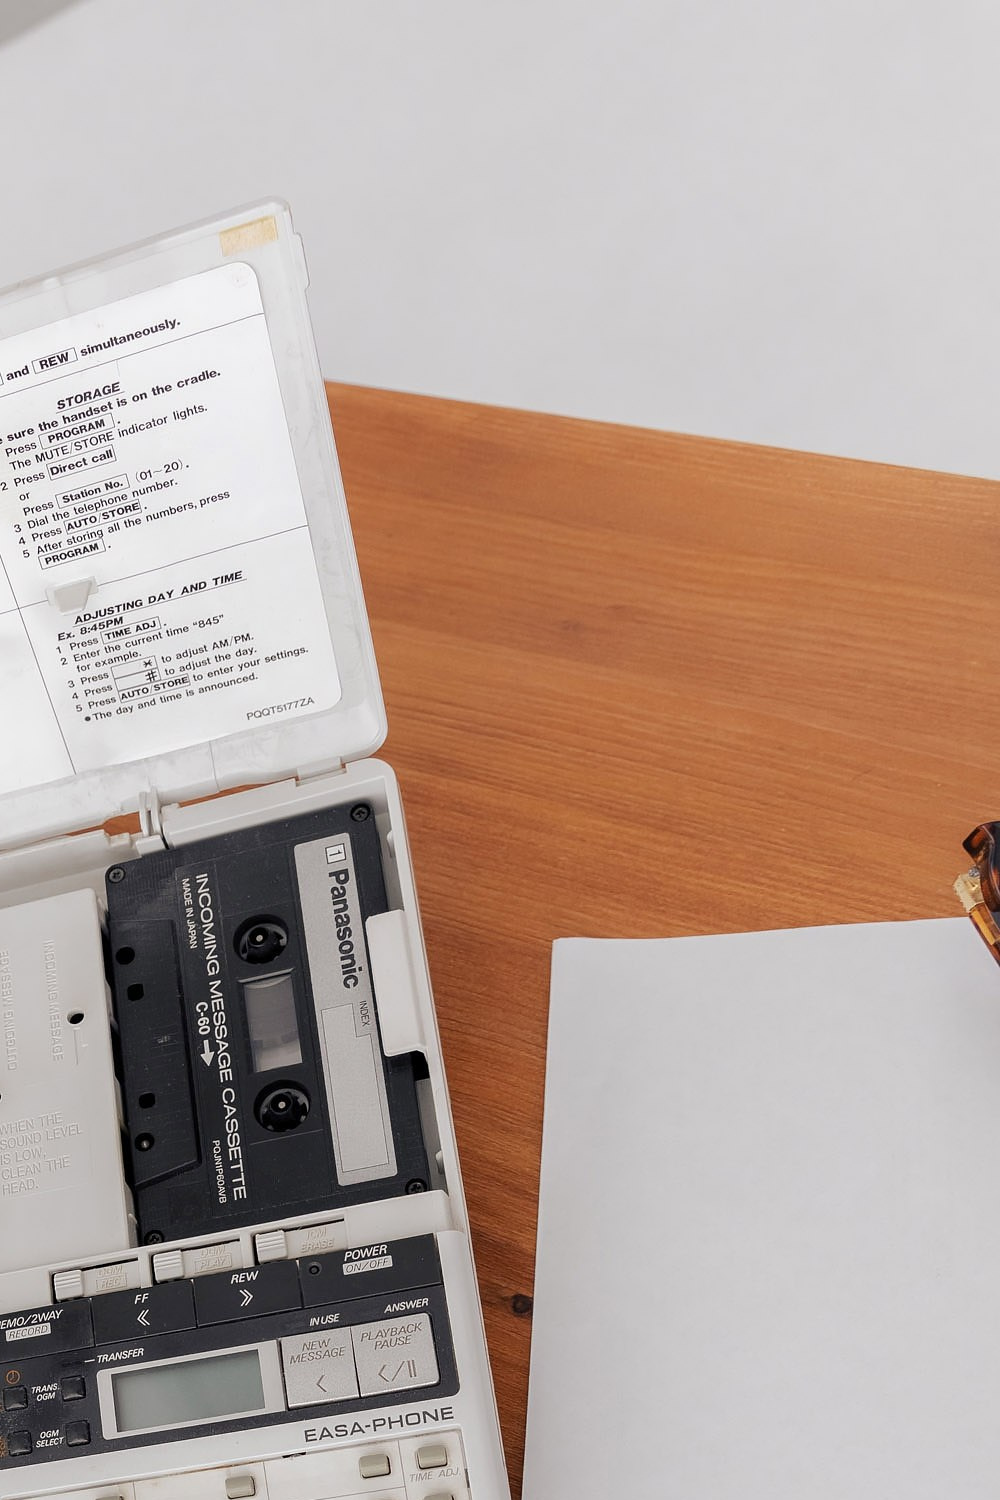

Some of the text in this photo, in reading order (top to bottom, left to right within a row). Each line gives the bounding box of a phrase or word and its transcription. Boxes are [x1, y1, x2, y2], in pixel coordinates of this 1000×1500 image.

[6, 365, 29, 380] and
[38, 352, 70, 369] REW
[80, 318, 180, 356] simultaneously.
[57, 382, 120, 409] STORAGE
[6, 428, 34, 441] sure
[38, 420, 58, 431] the
[62, 401, 113, 427] handset
[116, 398, 127, 407] is
[131, 392, 147, 402] on
[151, 384, 172, 396] the
[176, 370, 220, 388] cradle.
[74, 570, 242, 624] ADJUSTING DAY AND TIME
[246, 696, 314, 720] PQQT5177ZA
[181, 878, 197, 948] MADE IN JAPAN
[328, 868, 362, 988] Panasonic
[196, 1001, 210, 1036] C-60
[360, 1000, 370, 1028] INDEX
[195, 873, 246, 1200] INCOMING MESSAGE CASSETTE
[344, 1244, 388, 1262] POWER
[346, 1257, 390, 1273] ON/OFF
[230, 1270, 259, 1284] REW
[134, 1293, 149, 1304] FF
[384, 1298, 429, 1313] ANSWER
[309, 1314, 340, 1326] IN USE
[8, 1326, 49, 1339] RECORD
[360, 1322, 422, 1342] PLAYBACK
[302, 1338, 331, 1350] NEW
[374, 1335, 412, 1350] PAUSE
[97, 1348, 144, 1363] TRANSFER
[290, 1346, 346, 1365] MESSAGE
[31, 1383, 60, 1394] TRANS.
[36, 1392, 55, 1401] OGM
[304, 1406, 455, 1443] EASA-PHONE
[36, 1437, 64, 1448] SELECT
[40, 1430, 59, 1439] OGM
[409, 1471, 434, 1481] TIME
